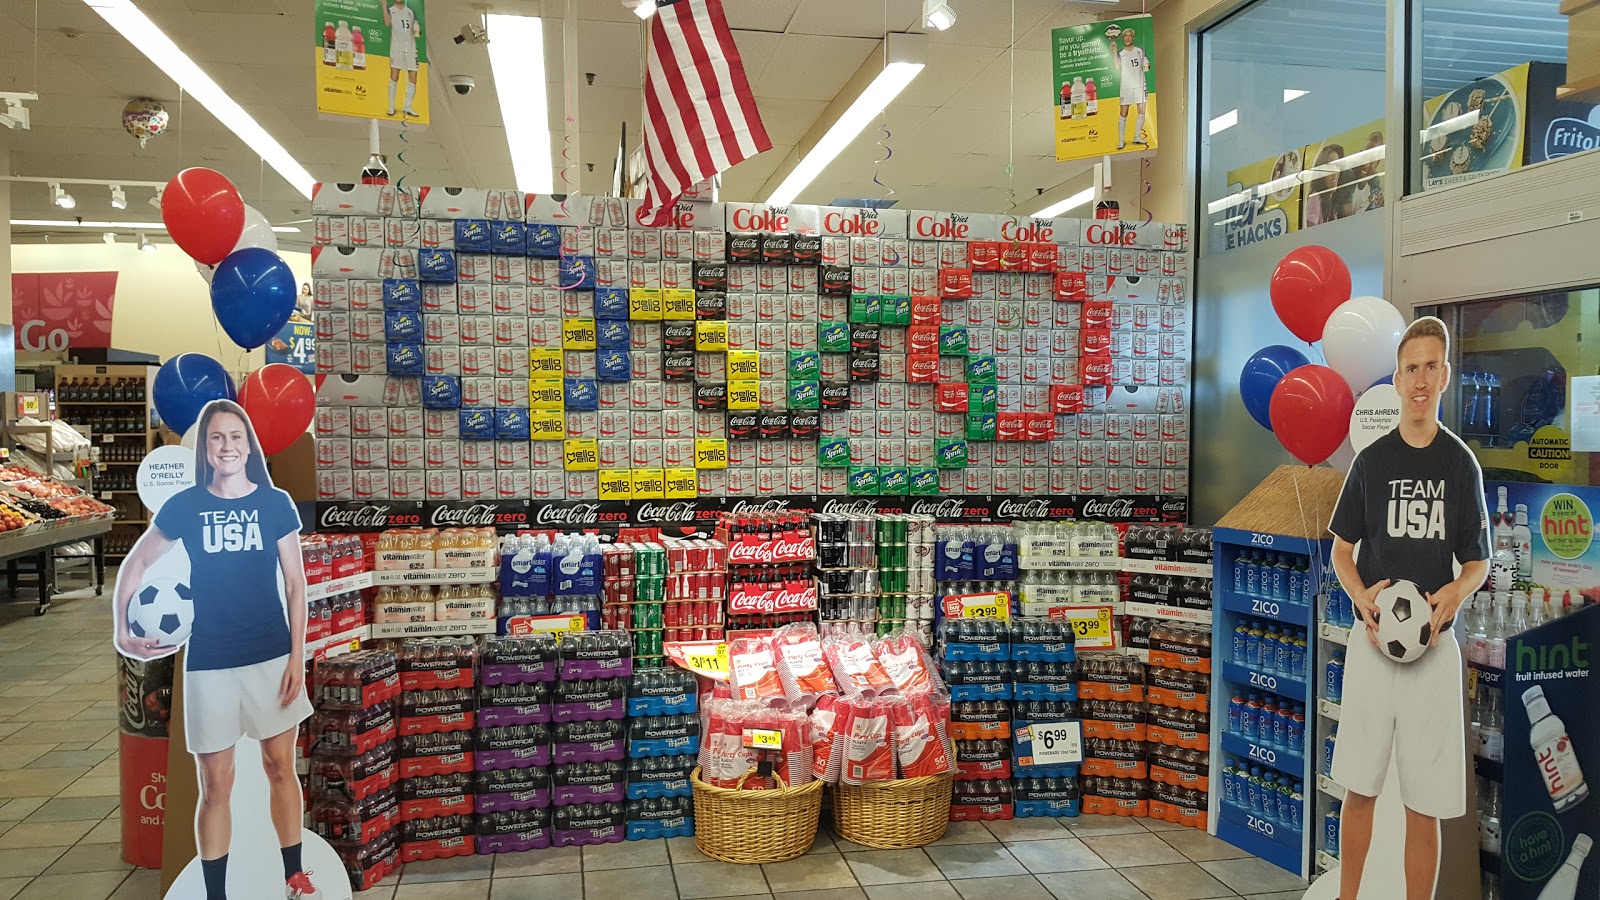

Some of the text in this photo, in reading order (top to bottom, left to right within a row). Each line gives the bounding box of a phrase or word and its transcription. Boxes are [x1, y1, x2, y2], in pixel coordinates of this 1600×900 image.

[1070, 43, 1080, 51] you
[1130, 58, 1139, 68] 15
[676, 203, 694, 213] Diet
[771, 206, 789, 216] Diet
[635, 205, 695, 229] Cke
[733, 208, 789, 231] Coke
[861, 210, 879, 220] Diet
[951, 213, 969, 223] Diet
[824, 212, 879, 235] Coke
[916, 215, 969, 239] Coke
[1036, 218, 1053, 228] Diet
[1120, 221, 1137, 231] Diet
[463, 225, 482, 238] Sprite
[1001, 220, 1054, 243] Coke
[1086, 224, 1137, 246] Coke
[1238, 217, 1282, 247] HACKS
[731, 238, 757, 249] Coca-Cola
[20, 320, 69, 352] Go
[293, 326, 313, 336] NOW:
[946, 333, 965, 346] Sprite
[1057, 391, 1081, 401] Coca-Cola
[1375, 408, 1400, 416] AHRENS
[467, 415, 486, 428] Sprite
[730, 416, 757, 426] Coca-Cola
[1532, 438, 1568, 446] AUTOMATIC
[826, 447, 845, 460] Sprite
[1530, 449, 1570, 459] CAUTION
[149, 463, 184, 471] HEATHER
[150, 471, 184, 479] O'REILLY
[916, 475, 935, 488] Sprite
[1388, 479, 1445, 499] TEAM
[823, 499, 879, 516] Coca-Cola
[877, 507, 903, 516] zero
[910, 499, 989, 520] Coca-Cola zero
[996, 499, 1074, 519] Coca-Cola zero
[1082, 499, 1158, 518] Coca-Cola zero
[1162, 501, 1185, 512] Coca-Cola
[1553, 500, 1574, 510] WIN
[199, 509, 258, 525] TEAM
[320, 504, 421, 528] Coca-Cola zero
[431, 503, 528, 528] Coca-Cola zero
[536, 503, 628, 526] Coca-Cola zero
[636, 502, 723, 523] Coca-Cola zero
[1387, 500, 1446, 540] USA
[1544, 515, 1590, 535] hint
[202, 523, 264, 553] USA
[1251, 533, 1274, 545] ZICO
[382, 553, 425, 561] vitaminwater
[512, 559, 547, 567] smartwater
[403, 571, 447, 580] vitaminwater
[1154, 564, 1197, 574] vitaminwater
[1157, 608, 1198, 618] vitaminwater
[1252, 599, 1280, 615] ZICO
[404, 624, 449, 633] vitaminwater
[576, 650, 619, 658] POWERADE
[1516, 636, 1590, 671] hint
[411, 659, 457, 668] POWERADE
[1087, 673, 1129, 681] POWERADE
[1249, 671, 1277, 690] ZICO
[1516, 668, 1590, 681] fruit infused water
[642, 686, 684, 694] POWERADE
[1248, 743, 1276, 763] ZICO
[935, 755, 945, 766] 50
[1538, 746, 1565, 797] hint
[416, 786, 462, 796] POWERADE
[140, 815, 160, 825] and
[1247, 815, 1274, 836] ZICO
[1519, 829, 1549, 849] have
